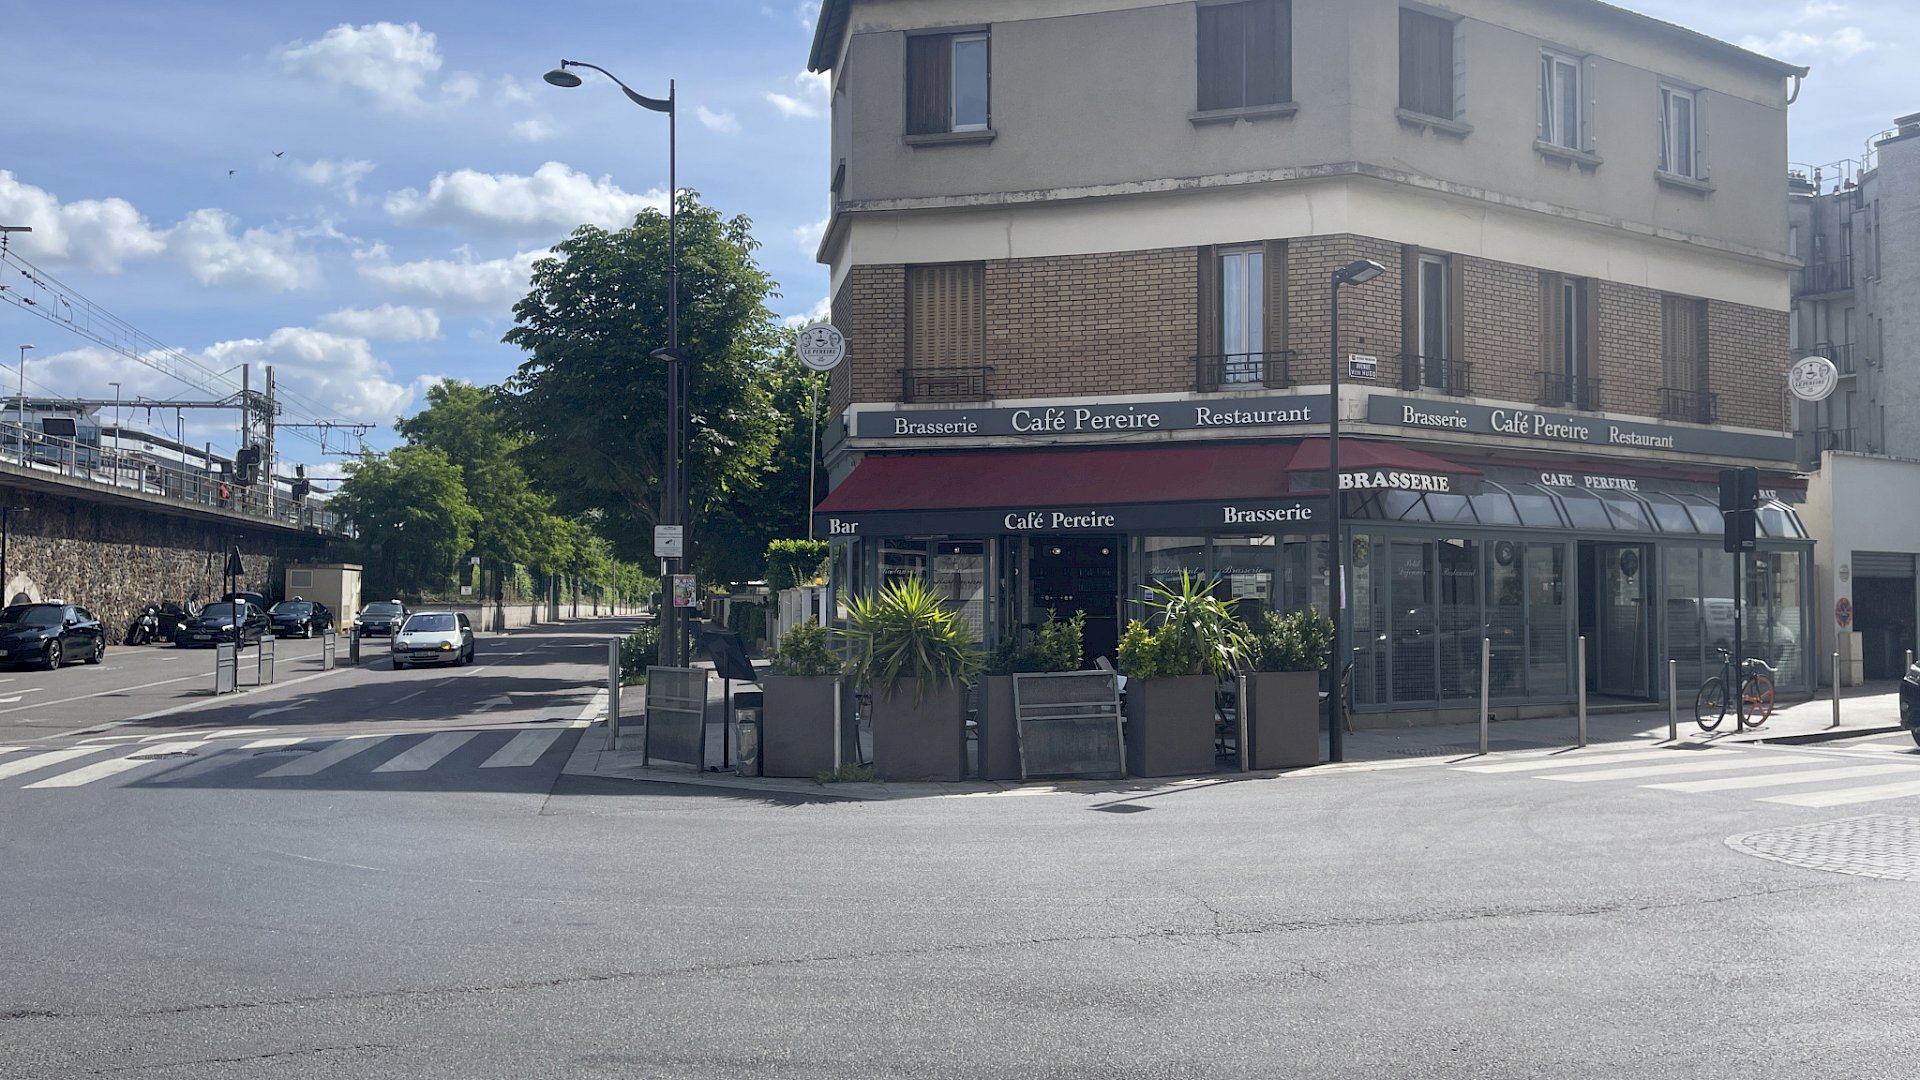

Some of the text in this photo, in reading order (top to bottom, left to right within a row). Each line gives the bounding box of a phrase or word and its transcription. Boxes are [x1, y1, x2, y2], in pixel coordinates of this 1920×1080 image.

[894, 417, 978, 435] Brasserie
[1011, 406, 1160, 432] Café Pereire
[1195, 405, 1312, 427] Restaurant
[1402, 404, 1468, 429] Brasserie
[1491, 408, 1589, 441] Café Pereire
[1609, 426, 1674, 449] Restaurant
[1338, 471, 1450, 493] BRASSERIE
[1541, 472, 1638, 492] CAFE PEREIRE
[1004, 510, 1114, 531] Café Pereire
[1223, 503, 1312, 524] Brasserie
[828, 517, 859, 534] Bar
[1148, 566, 1199, 575] Restaunt
[1221, 565, 1264, 574] Brasserie
